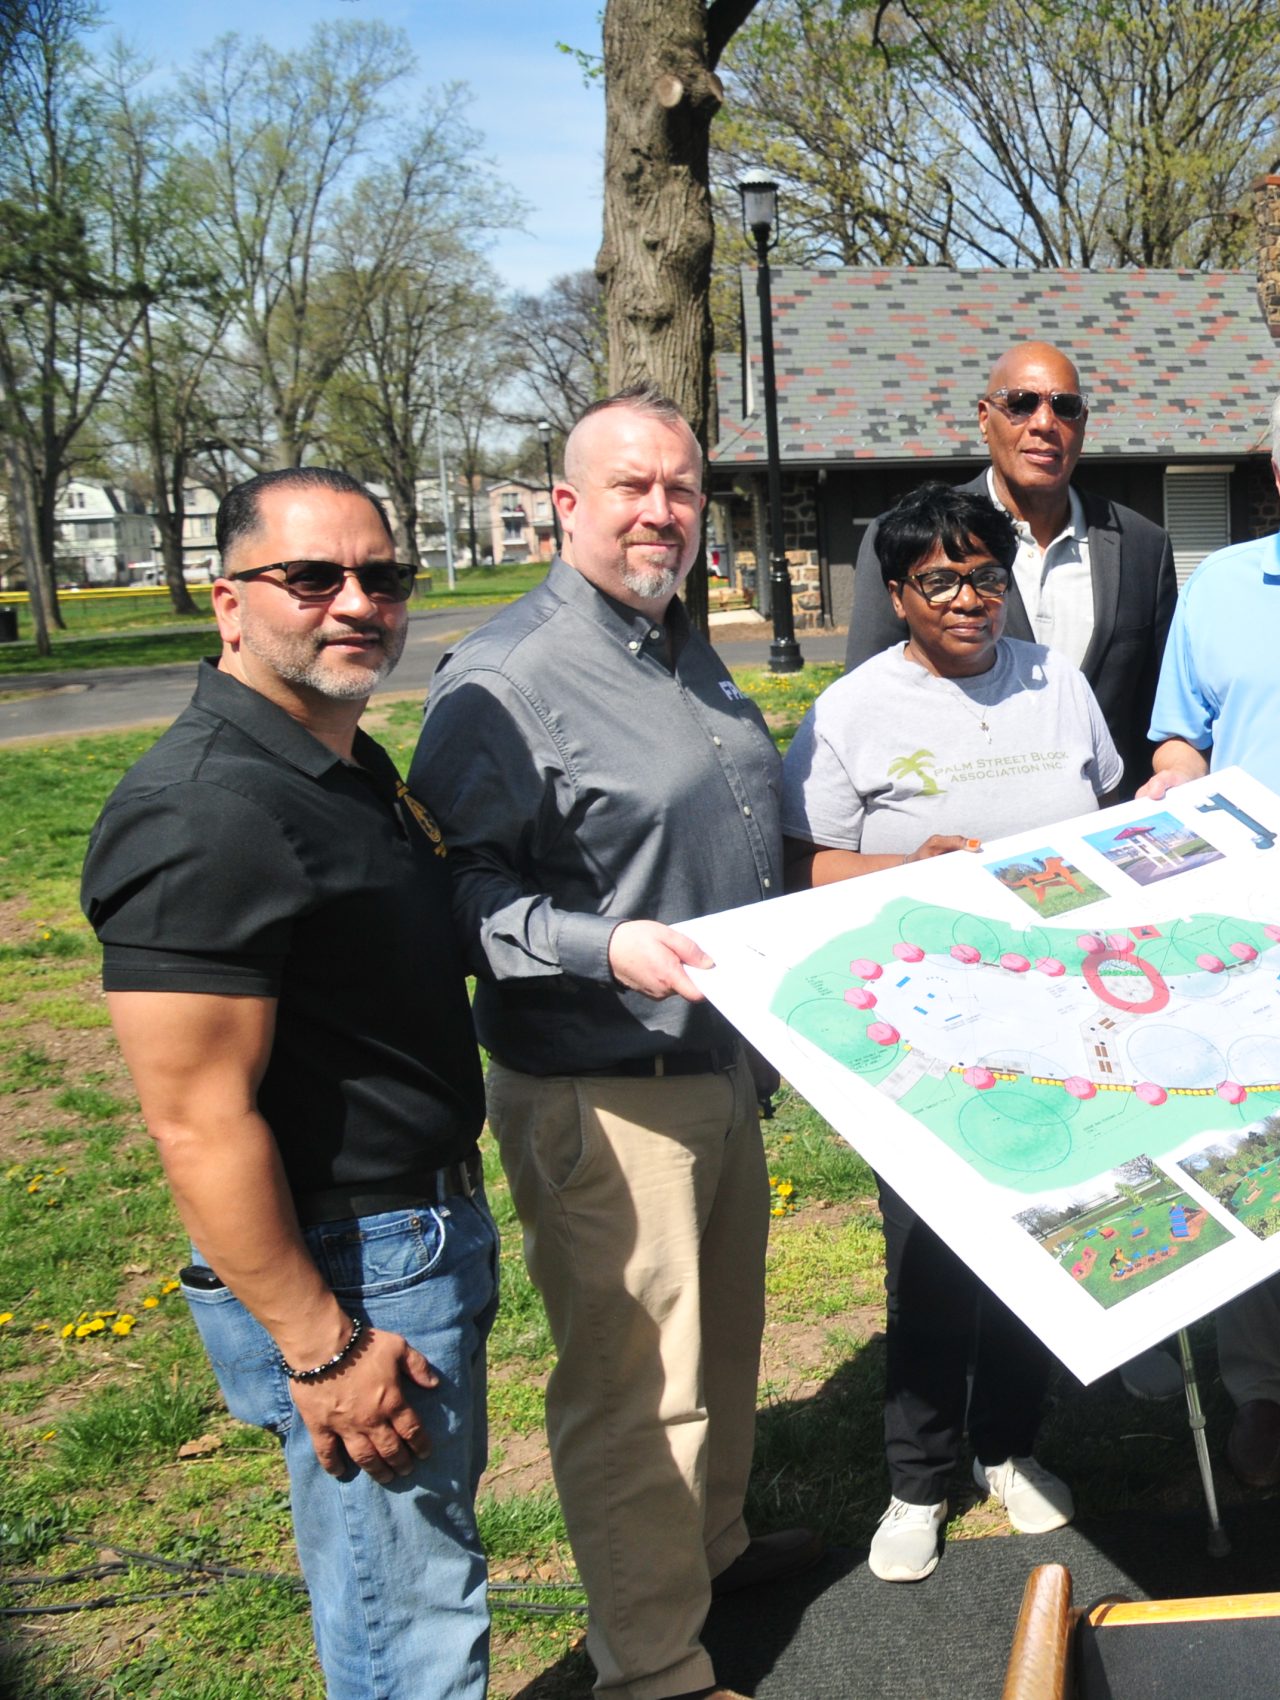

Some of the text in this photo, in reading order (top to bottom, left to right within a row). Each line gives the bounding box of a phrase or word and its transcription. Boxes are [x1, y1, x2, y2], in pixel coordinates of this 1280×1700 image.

[934, 761, 973, 777] PALM
[976, 754, 1027, 768] STREET
[950, 763, 1041, 783] ASSOCIATION
